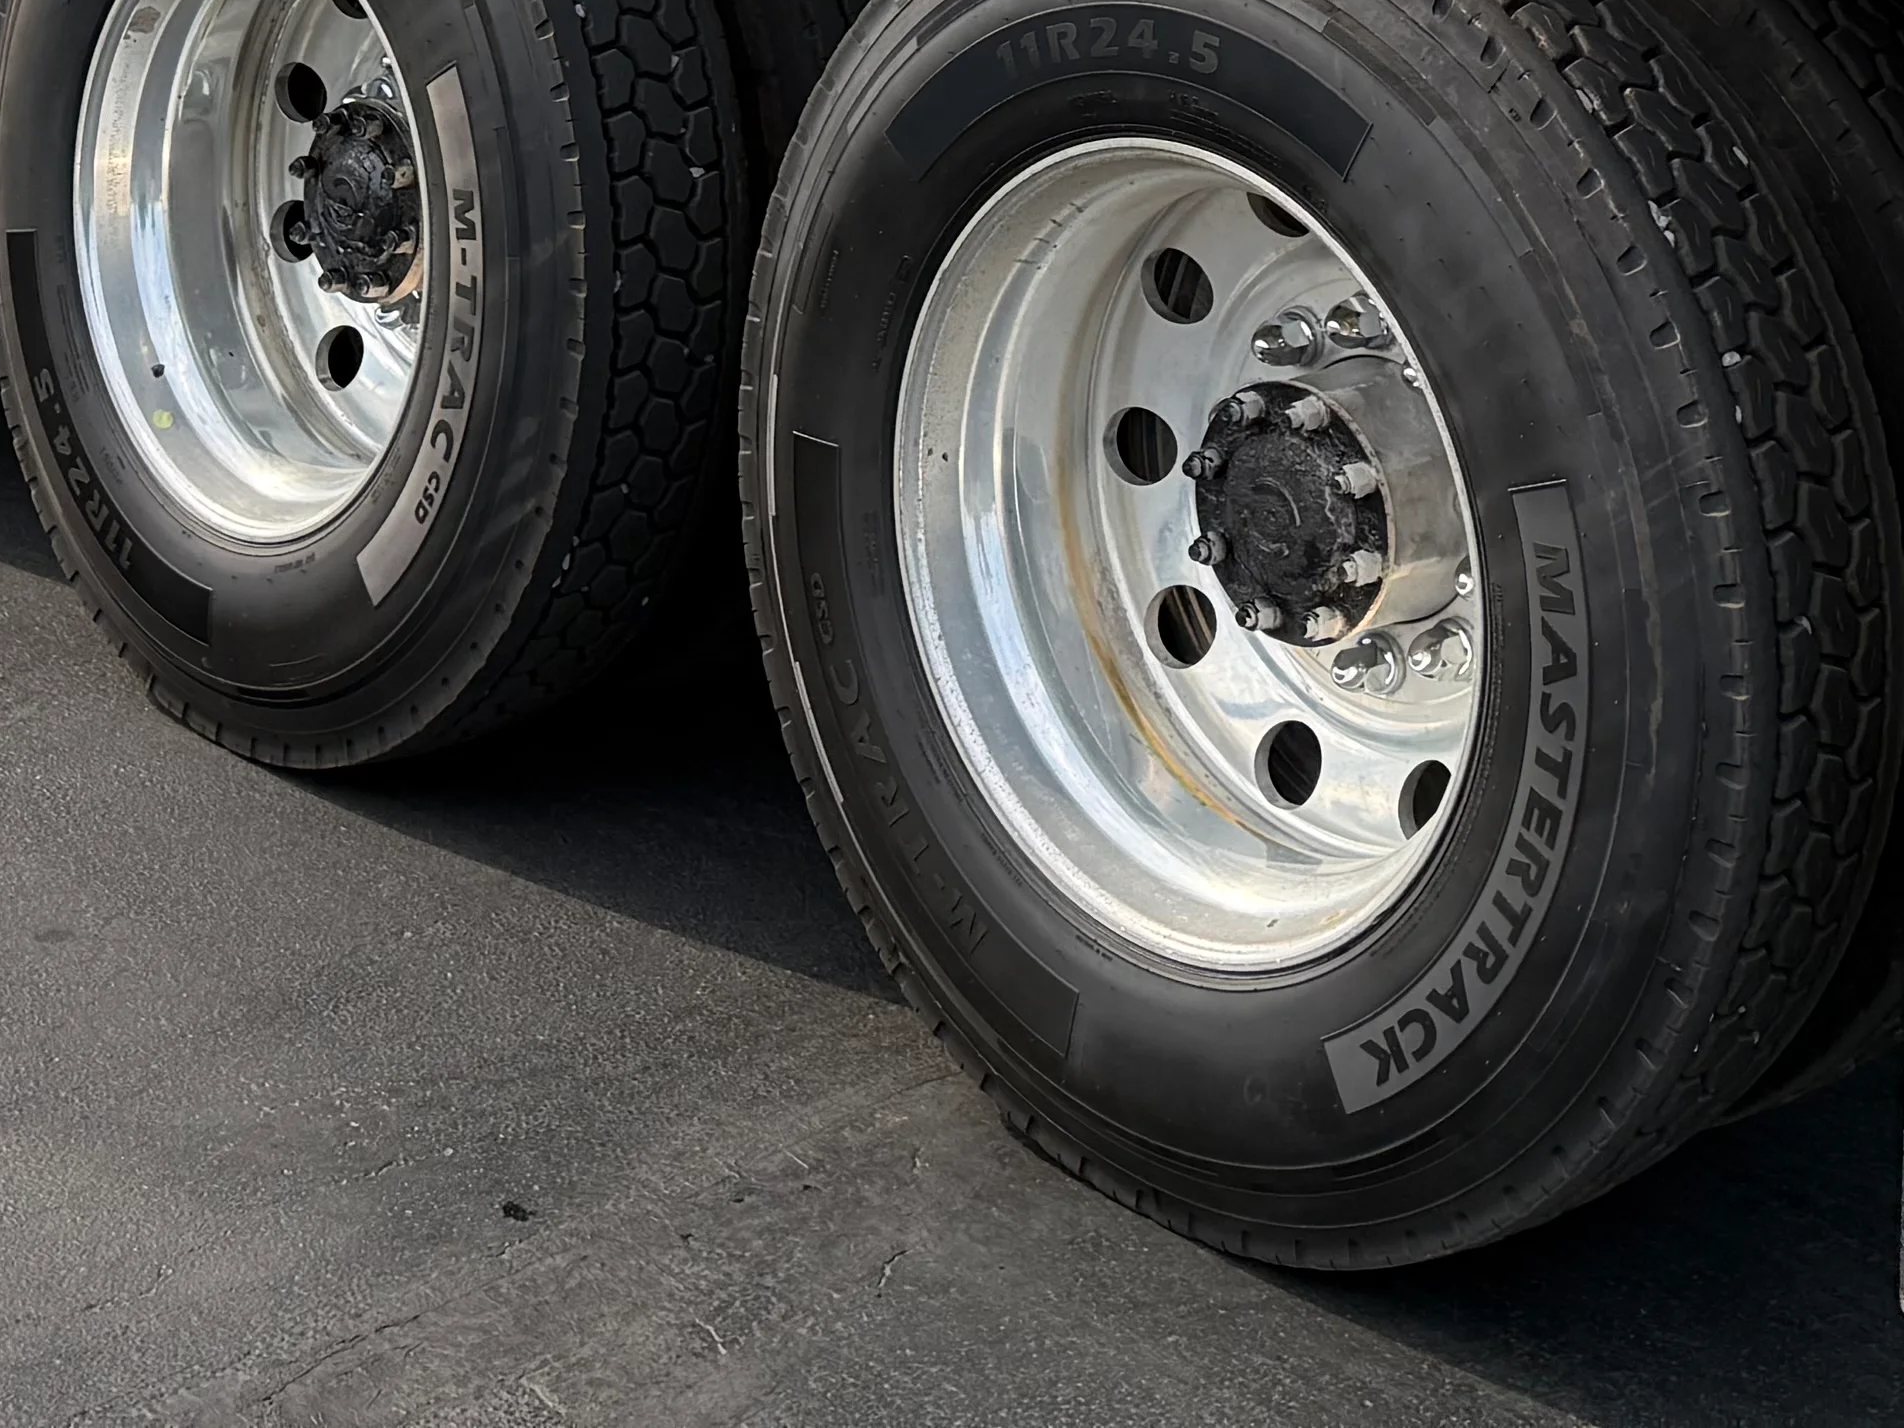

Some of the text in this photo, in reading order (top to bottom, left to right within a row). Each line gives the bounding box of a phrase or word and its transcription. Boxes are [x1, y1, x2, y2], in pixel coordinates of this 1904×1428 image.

[995, 15, 1222, 79] 11R24.5
[33, 367, 133, 571] 11R24.5
[414, 188, 479, 526] M-TRAC CSD
[1359, 541, 1579, 1087] MASTERTRACK
